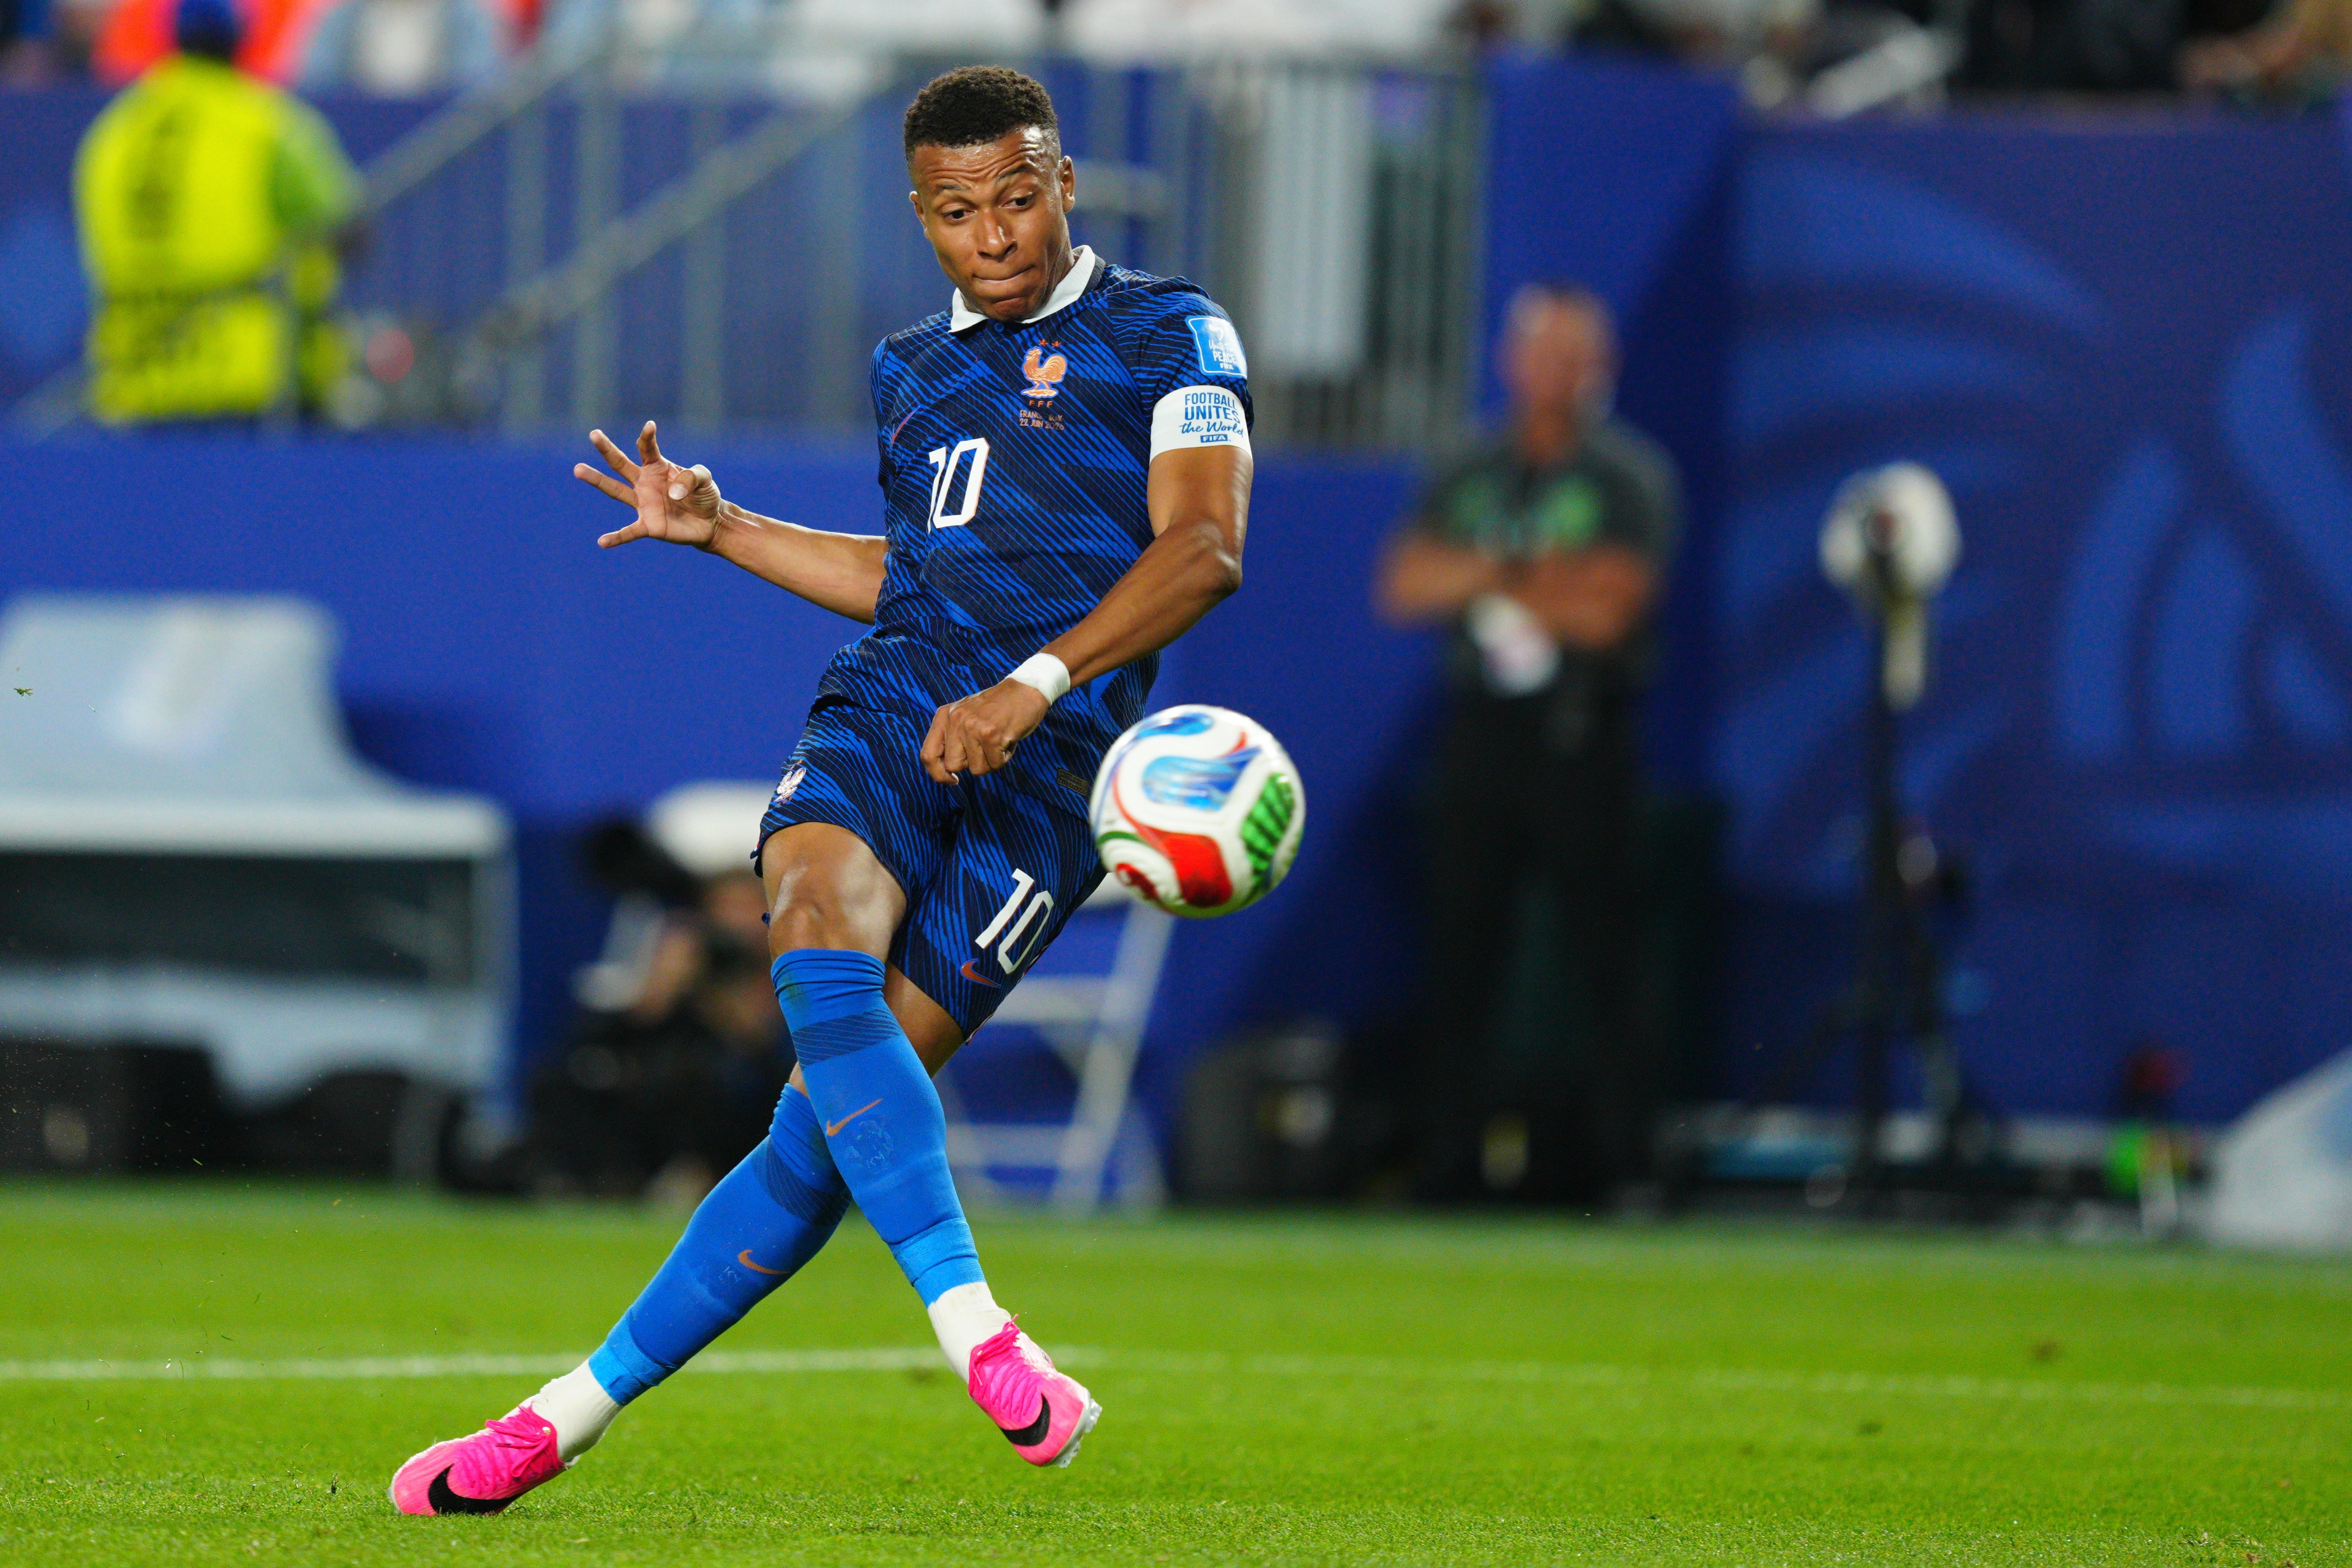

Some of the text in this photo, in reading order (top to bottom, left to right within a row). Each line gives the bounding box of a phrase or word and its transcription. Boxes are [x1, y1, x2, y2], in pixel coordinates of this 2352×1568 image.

[1212, 350, 1237, 364] PEACE
[1184, 392, 1238, 411] FOOTBALL
[1184, 405, 1240, 424] UNITES
[1179, 421, 1244, 438] the World
[927, 437, 990, 535] 10
[974, 868, 1055, 975] 10
